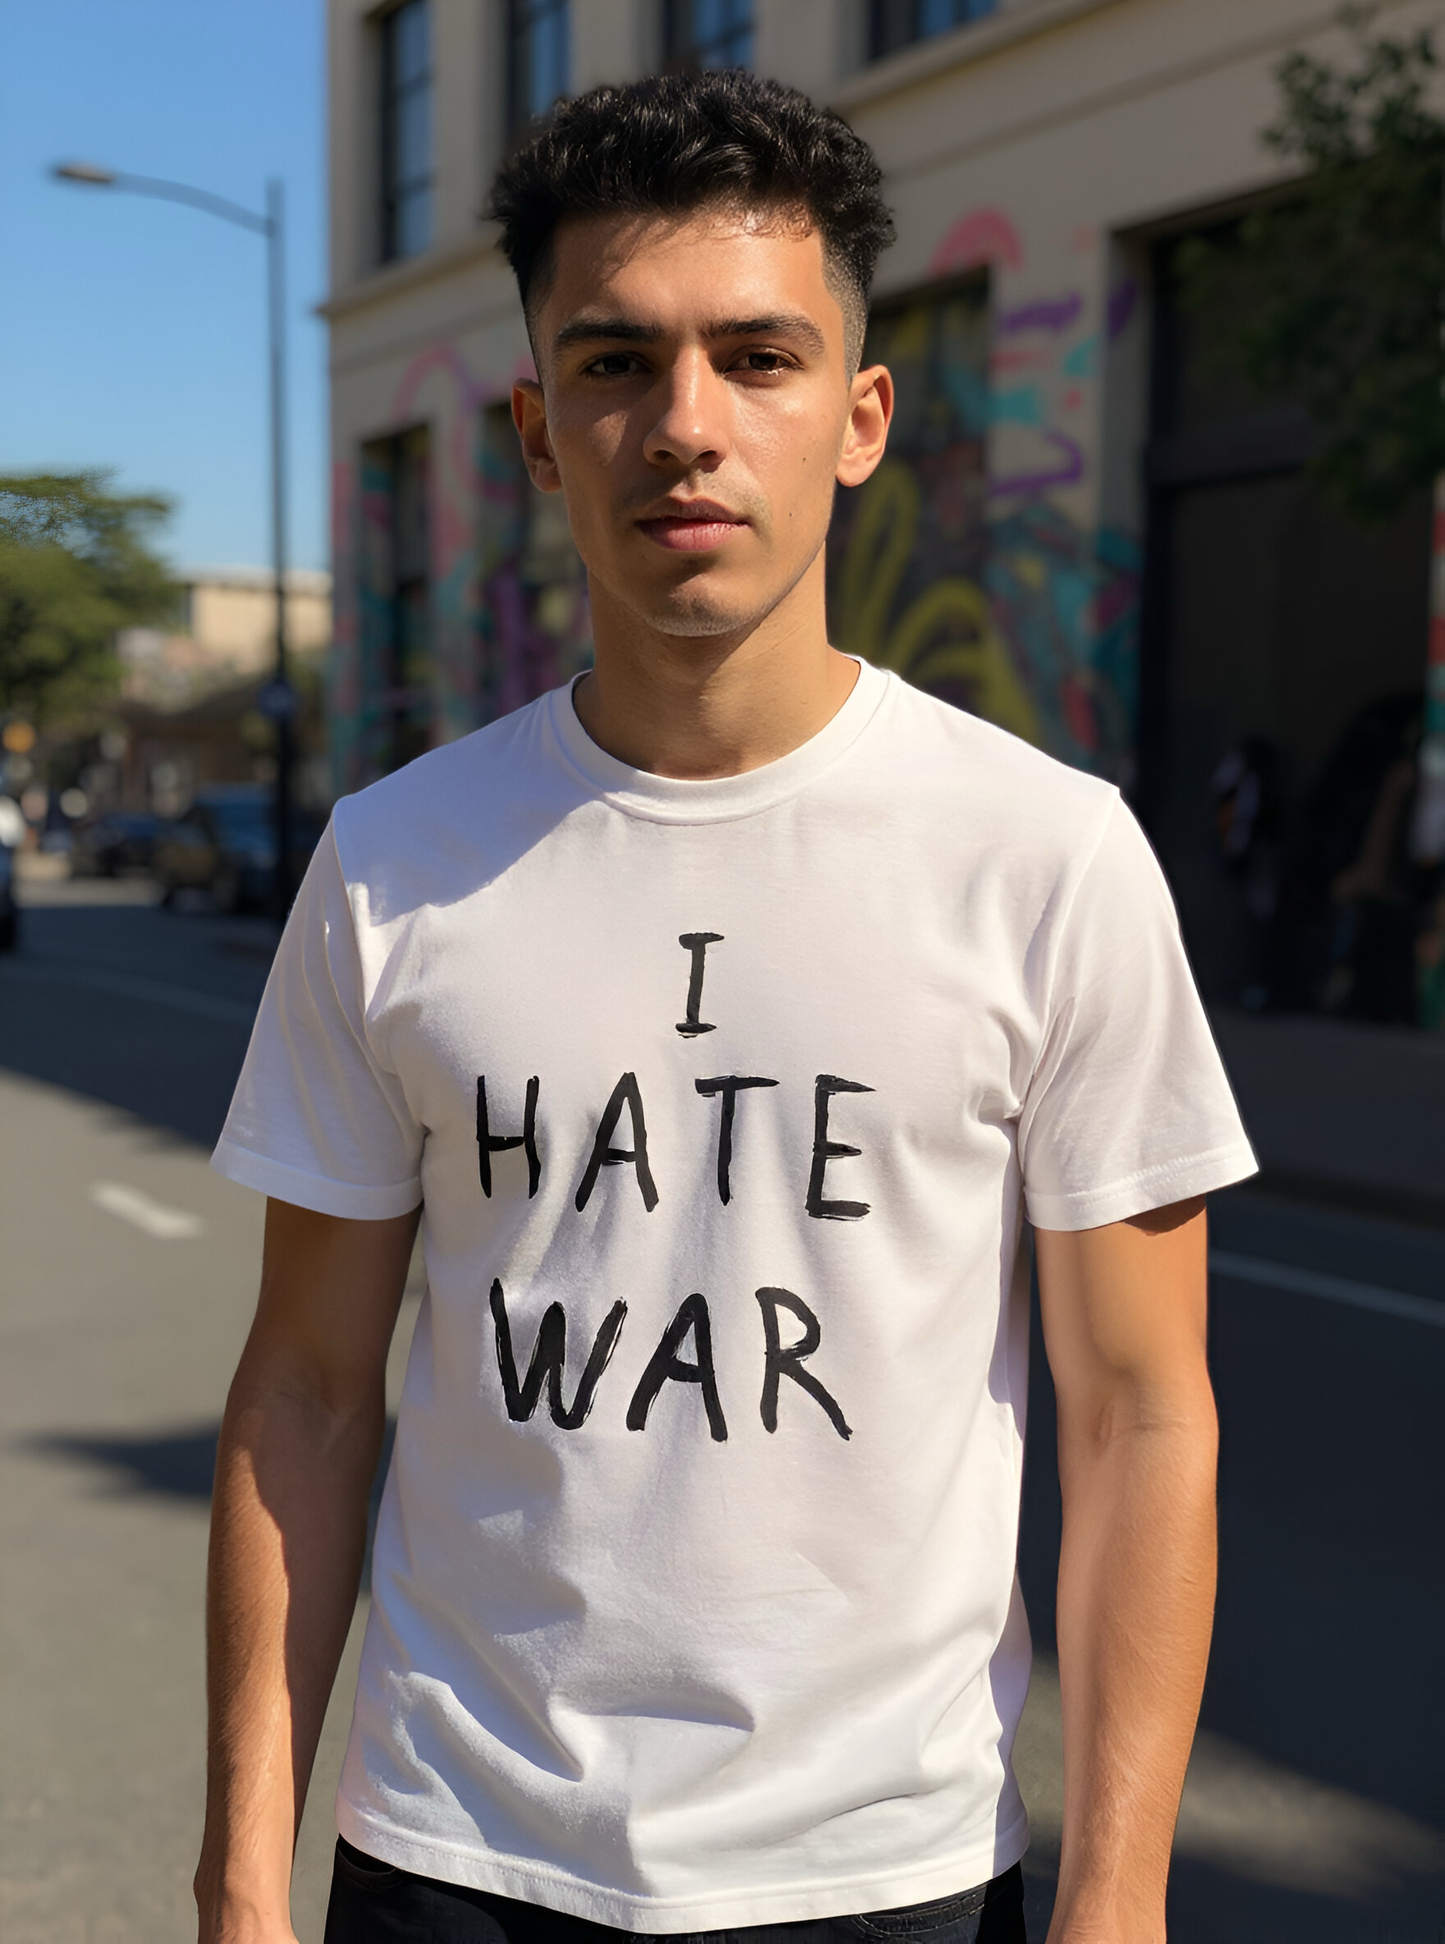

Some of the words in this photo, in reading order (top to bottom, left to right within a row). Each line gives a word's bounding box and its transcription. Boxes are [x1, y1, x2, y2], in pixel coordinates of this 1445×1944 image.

[674, 931, 725, 1038] I
[475, 1071, 877, 1221] HATE
[489, 1276, 854, 1443] WAR
